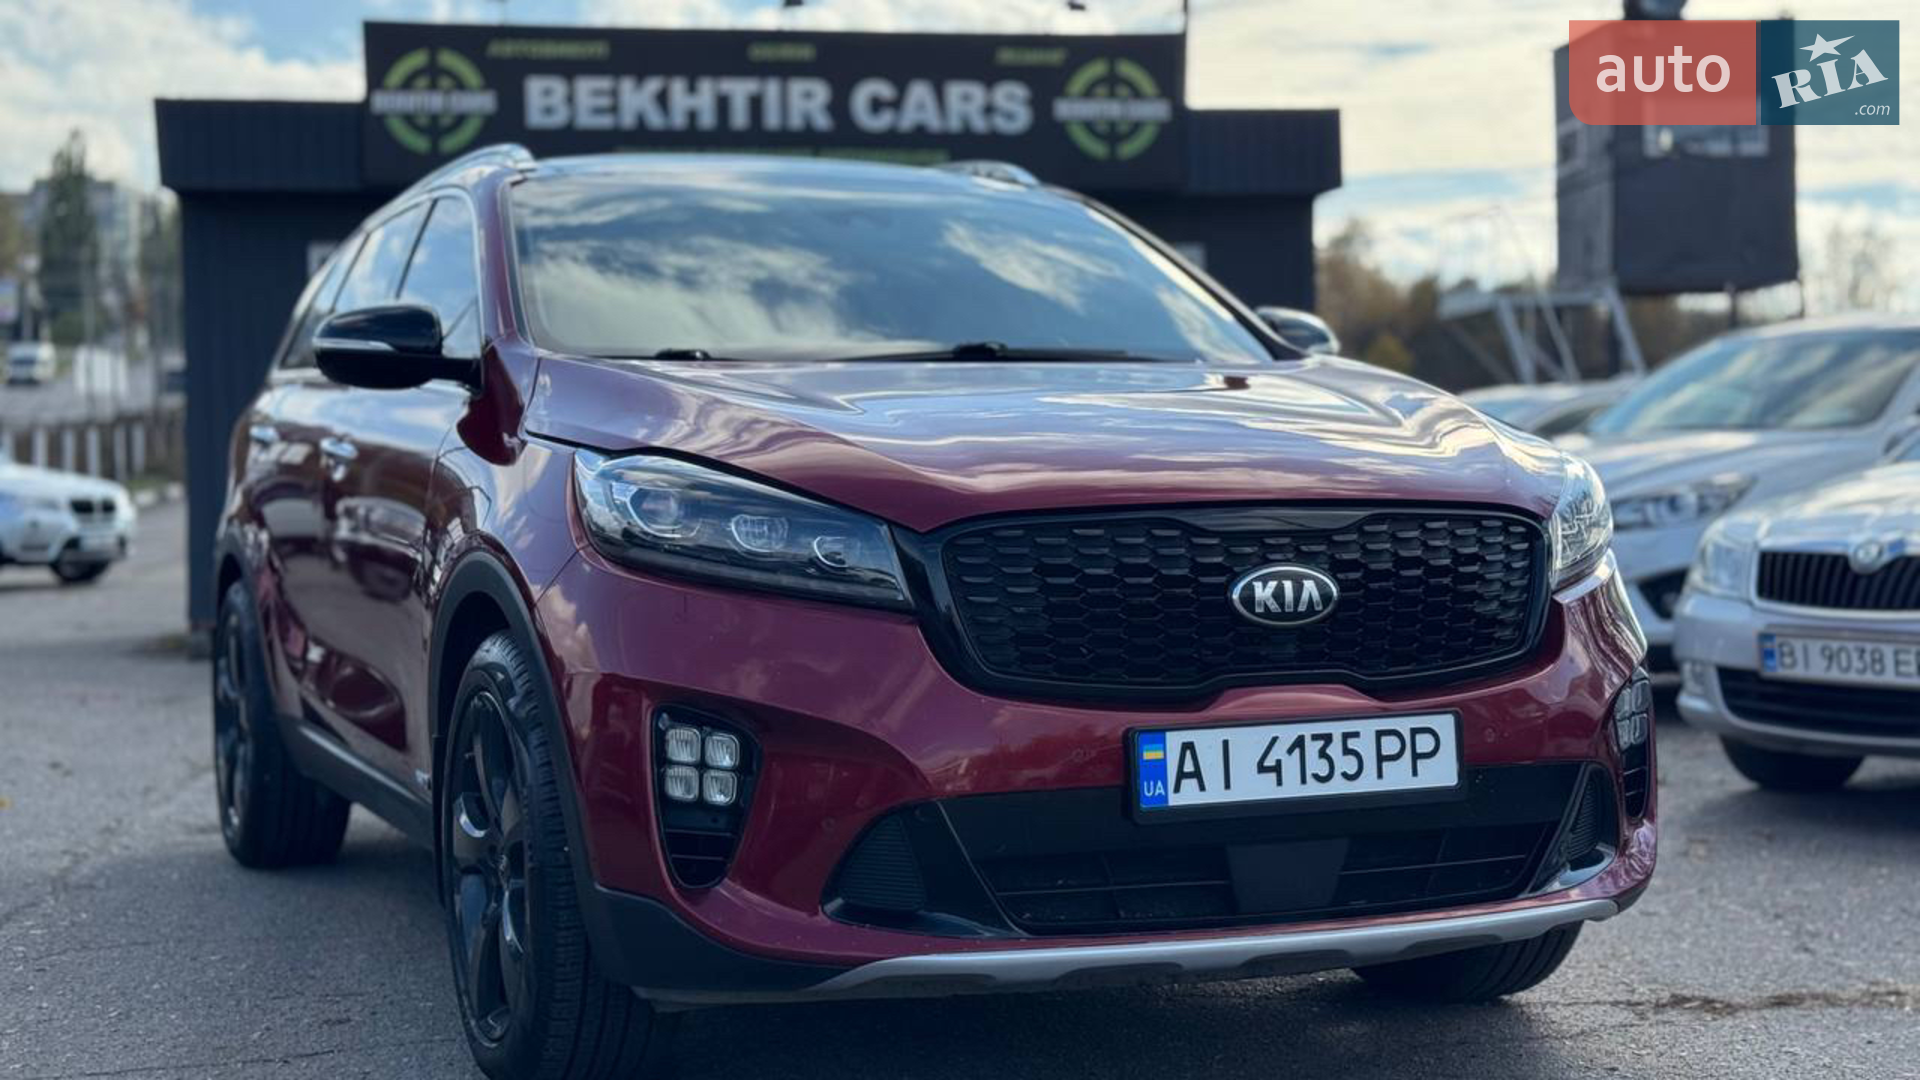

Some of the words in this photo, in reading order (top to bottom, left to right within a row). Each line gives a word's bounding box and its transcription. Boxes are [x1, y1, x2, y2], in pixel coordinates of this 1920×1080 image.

[523, 73, 834, 132] BEKHTIR
[849, 77, 1034, 135] CARS
[1252, 580, 1323, 613] KIA
[1820, 643, 1886, 676] 9038
[1173, 739, 1231, 794] AI
[1143, 780, 1166, 797] UA
